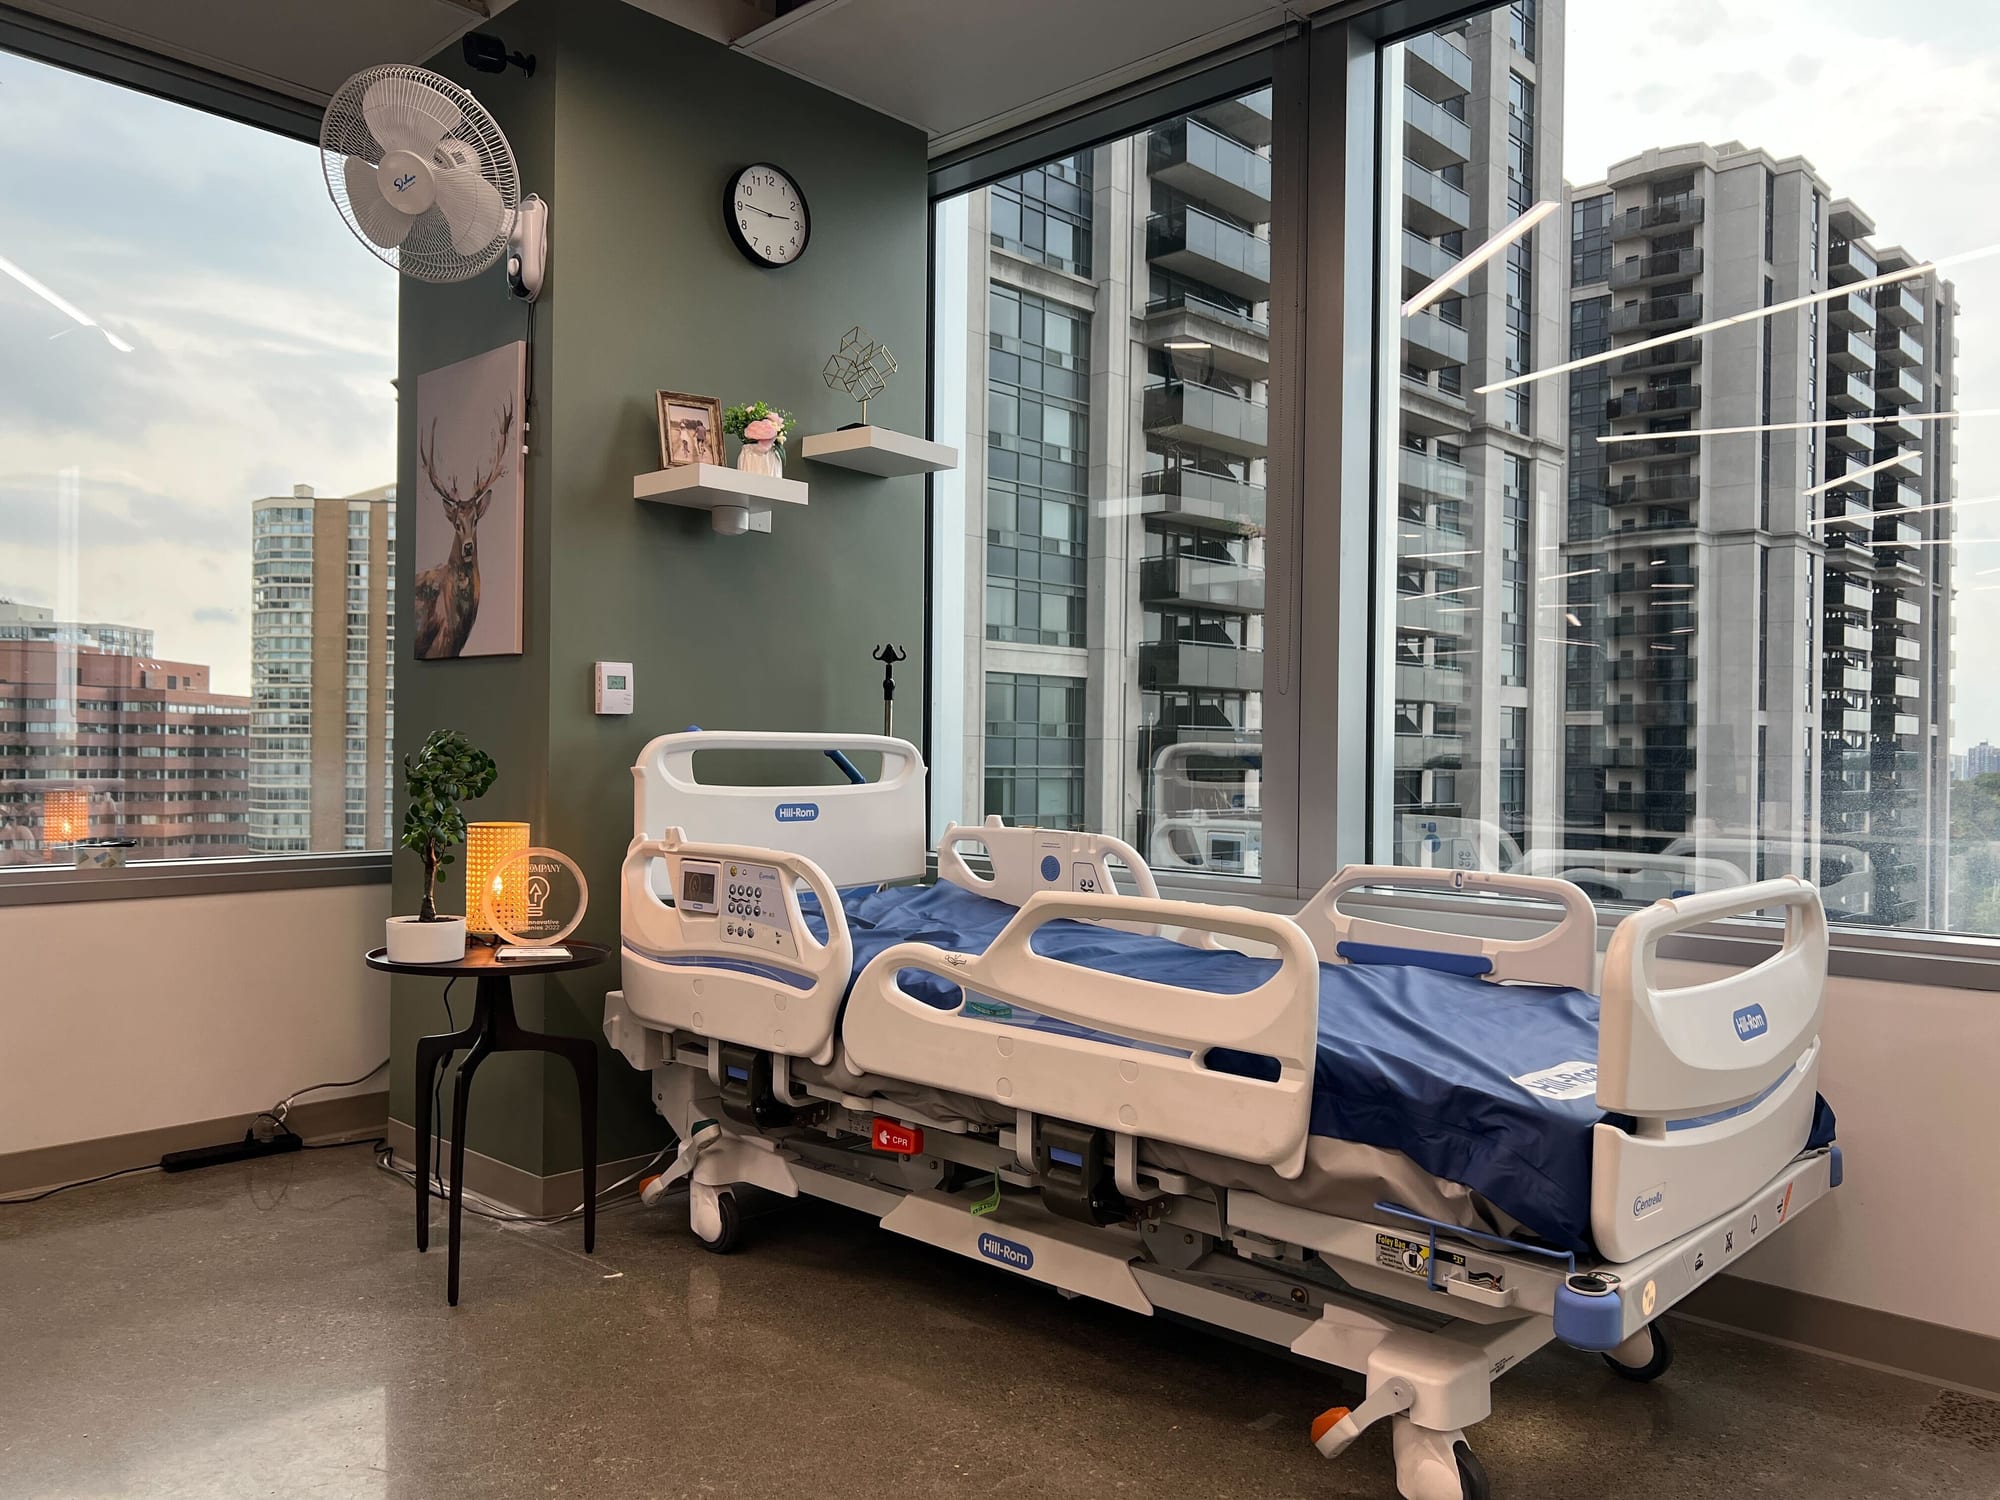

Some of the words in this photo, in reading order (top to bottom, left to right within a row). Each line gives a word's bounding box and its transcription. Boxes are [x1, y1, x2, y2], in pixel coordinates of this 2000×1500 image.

[752, 175, 761, 186] 11
[764, 175, 775, 187] 12
[742, 185, 752, 196] 10
[781, 187, 785, 196] 1
[737, 201, 743, 211] 9
[790, 201, 796, 211] 2
[741, 220, 747, 230] 8
[794, 221, 800, 231] 3
[753, 236, 758, 246] 7
[790, 237, 795, 246] 4
[765, 245, 771, 256] 6
[779, 245, 785, 256] 5
[780, 807, 815, 818] Hill-Rom
[1735, 1014, 1765, 1034] Hill-Rom
[892, 1136, 908, 1147] CPR
[1633, 1191, 1662, 1217] Centrella
[1377, 1234, 1394, 1248] Foley
[1394, 1238, 1406, 1250] Bag
[983, 1238, 1028, 1265] Hill-Rom
